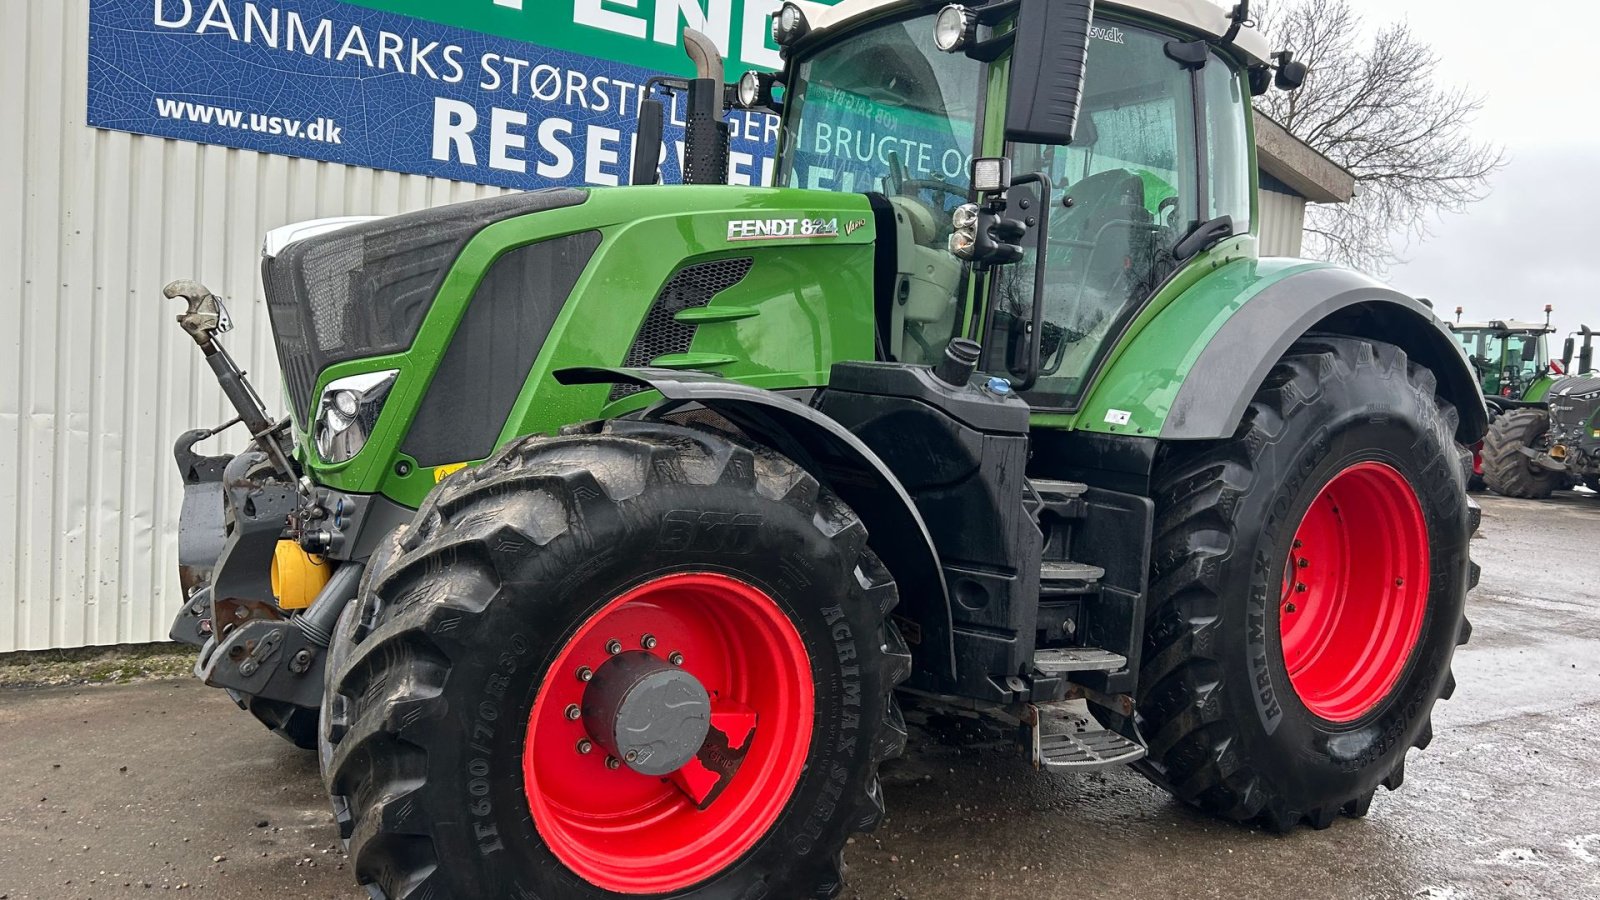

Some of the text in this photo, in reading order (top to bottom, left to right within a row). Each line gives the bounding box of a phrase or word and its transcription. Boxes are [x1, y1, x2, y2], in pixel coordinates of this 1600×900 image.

[154, 0, 464, 84] DANMARKS
[815, 122, 932, 173] BRUGTE
[156, 98, 341, 144] www.usv.dk
[728, 219, 798, 238] FENDT
[800, 218, 838, 235] 824
[820, 603, 862, 758] AGRIMAX
